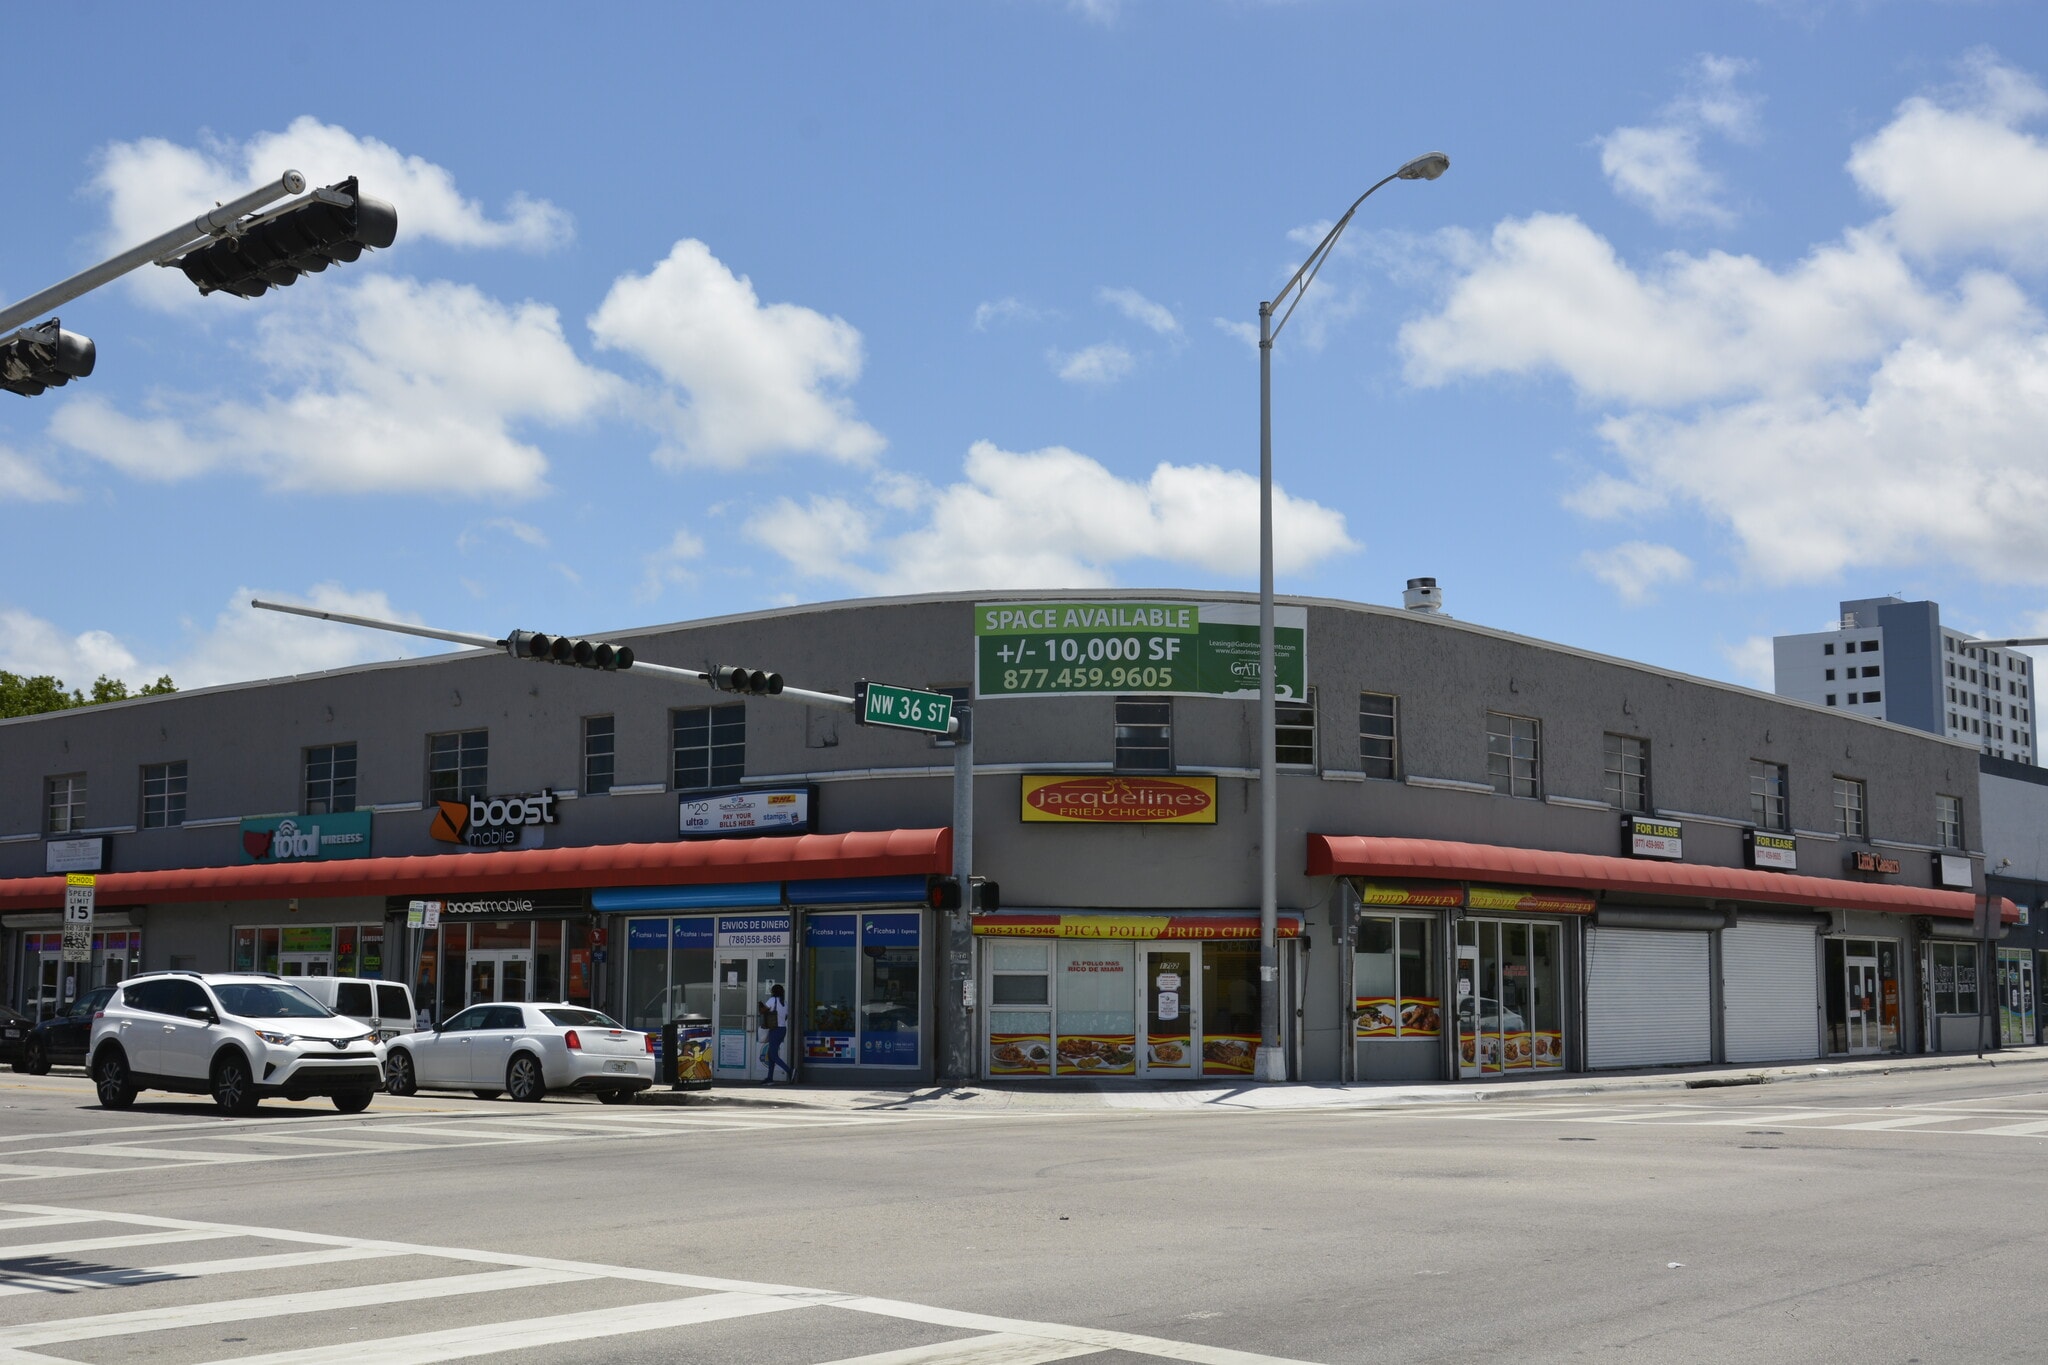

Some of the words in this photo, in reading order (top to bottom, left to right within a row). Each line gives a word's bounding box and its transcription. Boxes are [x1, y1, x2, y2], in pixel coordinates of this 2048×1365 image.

[986, 609, 1057, 630] SPACE
[1063, 608, 1190, 629] AVAILABLE
[1044, 637, 1141, 665] 10,000
[1148, 637, 1180, 661] SF
[1003, 667, 1173, 690] 877.459.9605
[870, 693, 894, 715] NW
[898, 696, 922, 721] 36
[927, 702, 946, 723] ST
[772, 795, 792, 803] DHL
[1036, 789, 1206, 808] jacquelines
[470, 789, 554, 827] boost
[1059, 808, 1104, 816] FRIED
[1108, 808, 1178, 817] CHICKEN
[736, 812, 752, 820] YOUR
[719, 820, 737, 828] BILLS
[738, 819, 755, 827] HERE
[1635, 823, 1652, 834] FOR
[1653, 825, 1679, 837] LEASE
[272, 825, 320, 858] total
[470, 829, 515, 845] mobile
[1756, 836, 1771, 846] FOR
[1771, 838, 1793, 849] LEASE
[68, 876, 93, 884] SCHOOL
[1368, 894, 1404, 905] FRIED
[1406, 895, 1458, 905] CHICKEN
[70, 905, 89, 920] 15
[721, 921, 749, 930] ENVIOS
[749, 920, 760, 929] DE
[761, 919, 790, 929] DINERO
[983, 927, 1056, 935] 305-216-2946
[1064, 925, 1101, 937] PICA
[1109, 925, 1161, 938] POLLO
[1168, 927, 1215, 937] FRIED
[1221, 927, 1295, 938] CHICEN
